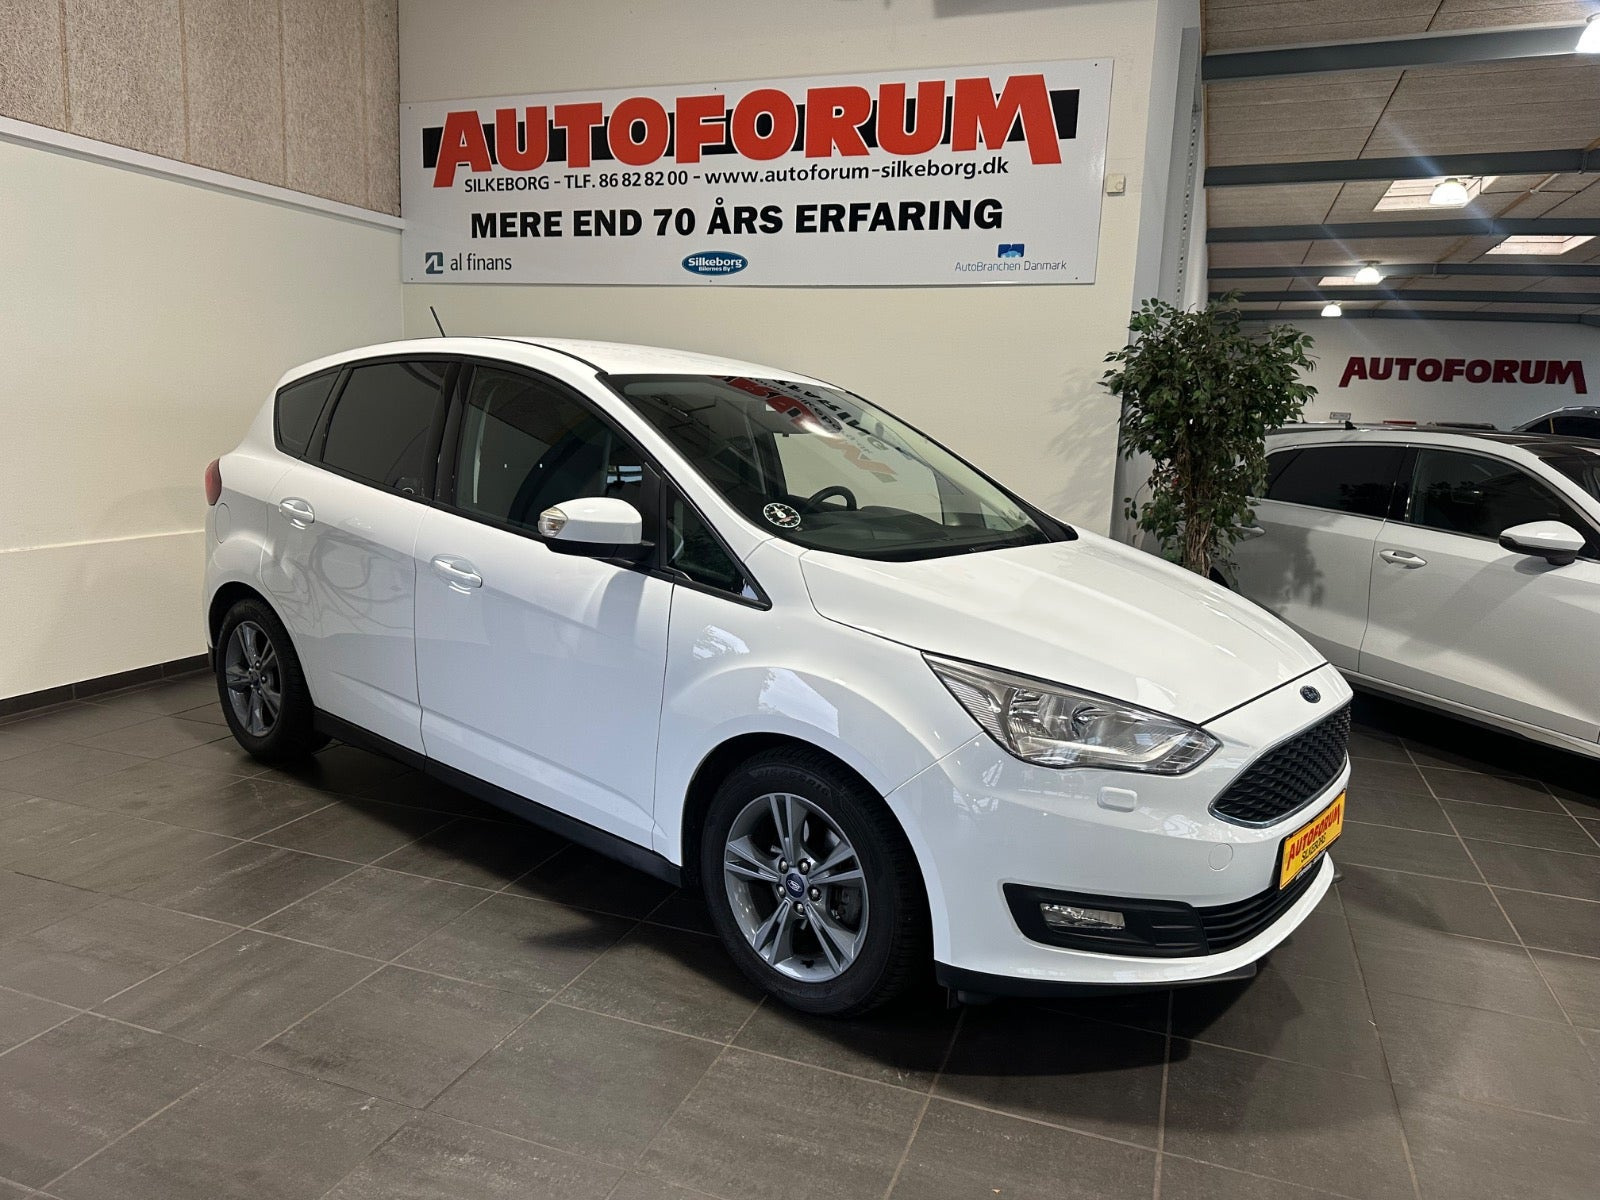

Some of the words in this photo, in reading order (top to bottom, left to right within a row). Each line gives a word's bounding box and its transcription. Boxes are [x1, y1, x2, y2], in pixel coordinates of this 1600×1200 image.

[433, 74, 1062, 188] AUTOFORUM
[464, 175, 550, 192] SILKEBORG
[564, 174, 596, 189] TLF.
[704, 156, 1009, 185] www.autoforum-silkeborg.dk
[471, 210, 563, 239] MERE
[573, 209, 643, 237] END
[652, 207, 696, 237] 70
[706, 197, 783, 235] ÅRS
[795, 198, 1003, 234] ERFARING
[450, 253, 462, 271] al
[466, 252, 512, 271] finans
[688, 256, 743, 269] Silkeborg
[954, 261, 1021, 272] AutoBranchen
[1023, 260, 1067, 271] Danmark
[1338, 356, 1588, 394] AUTOFORUM
[1286, 803, 1341, 871] AUTOFORUM
